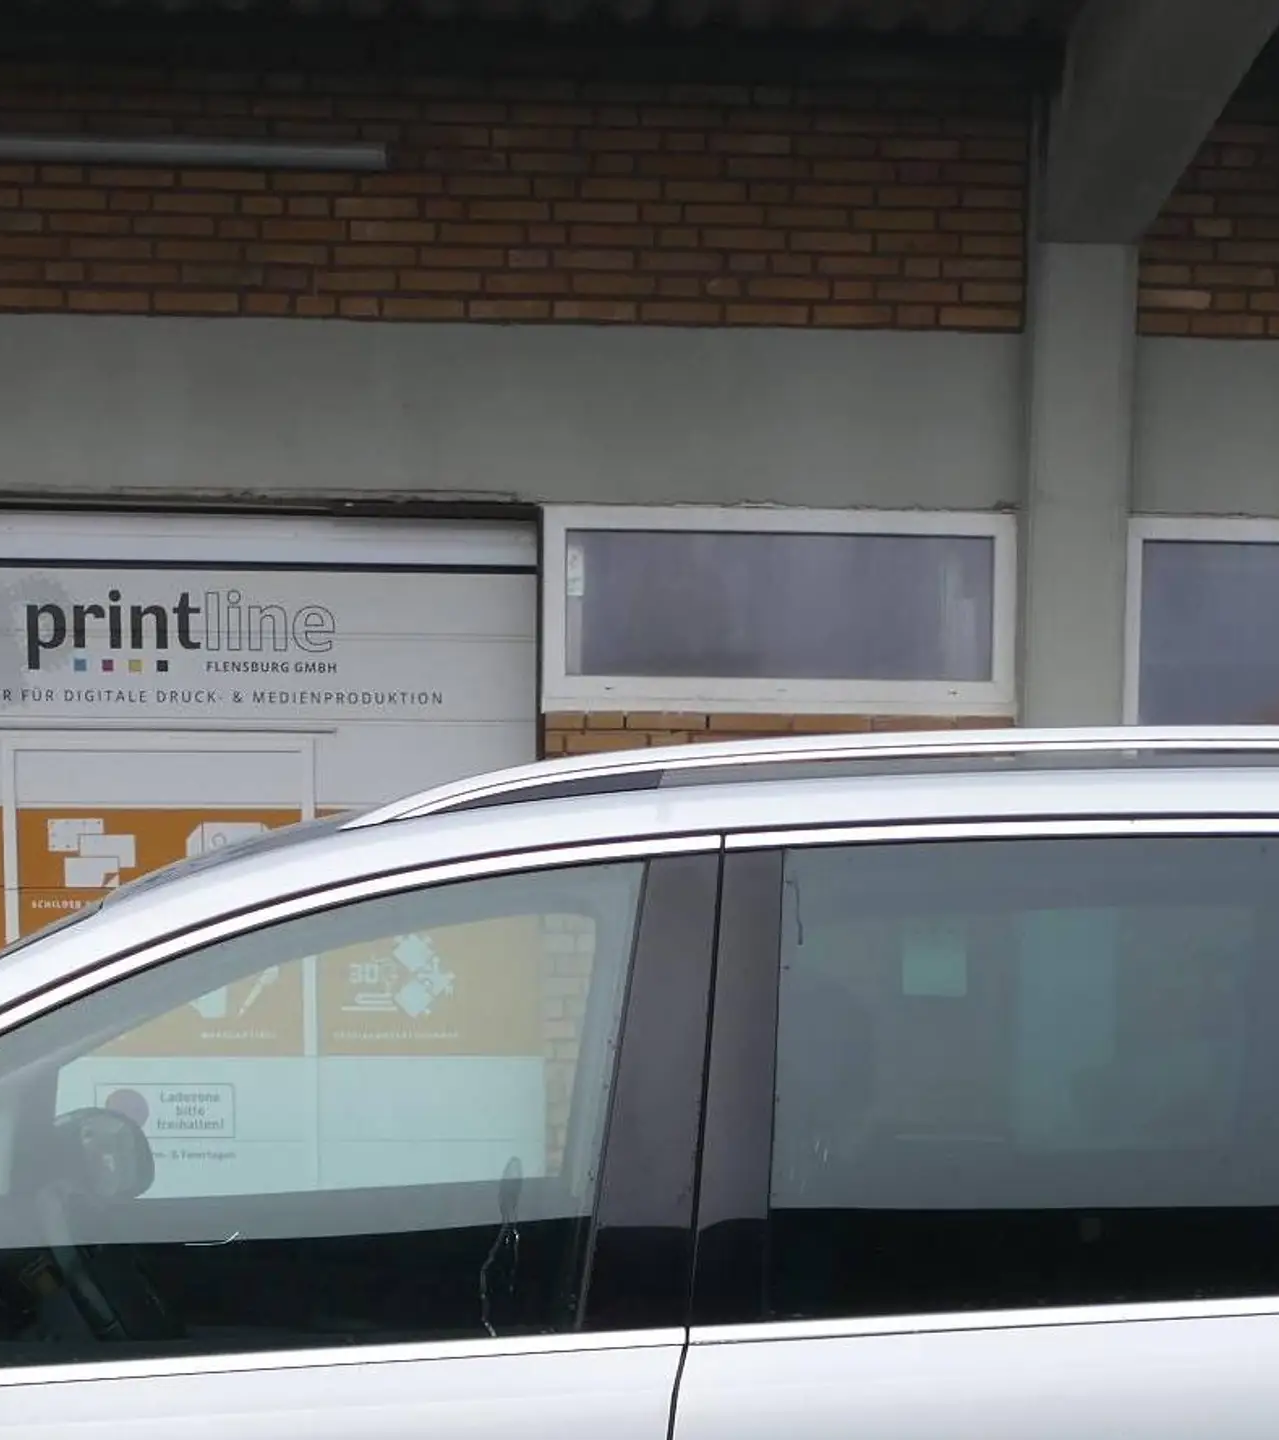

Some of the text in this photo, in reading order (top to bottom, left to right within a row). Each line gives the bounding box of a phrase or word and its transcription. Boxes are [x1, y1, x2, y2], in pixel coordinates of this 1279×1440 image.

[25, 590, 336, 670] printline
[206, 661, 338, 675] FLENSBURG GMBH
[21, 686, 55, 702] FÜR
[63, 689, 148, 703] DIGITALE
[231, 690, 244, 704] &
[252, 691, 444, 705] MEDIENPRODUKTION
[159, 1089, 221, 1103] Ladezone
[175, 1104, 207, 1117] bitte
